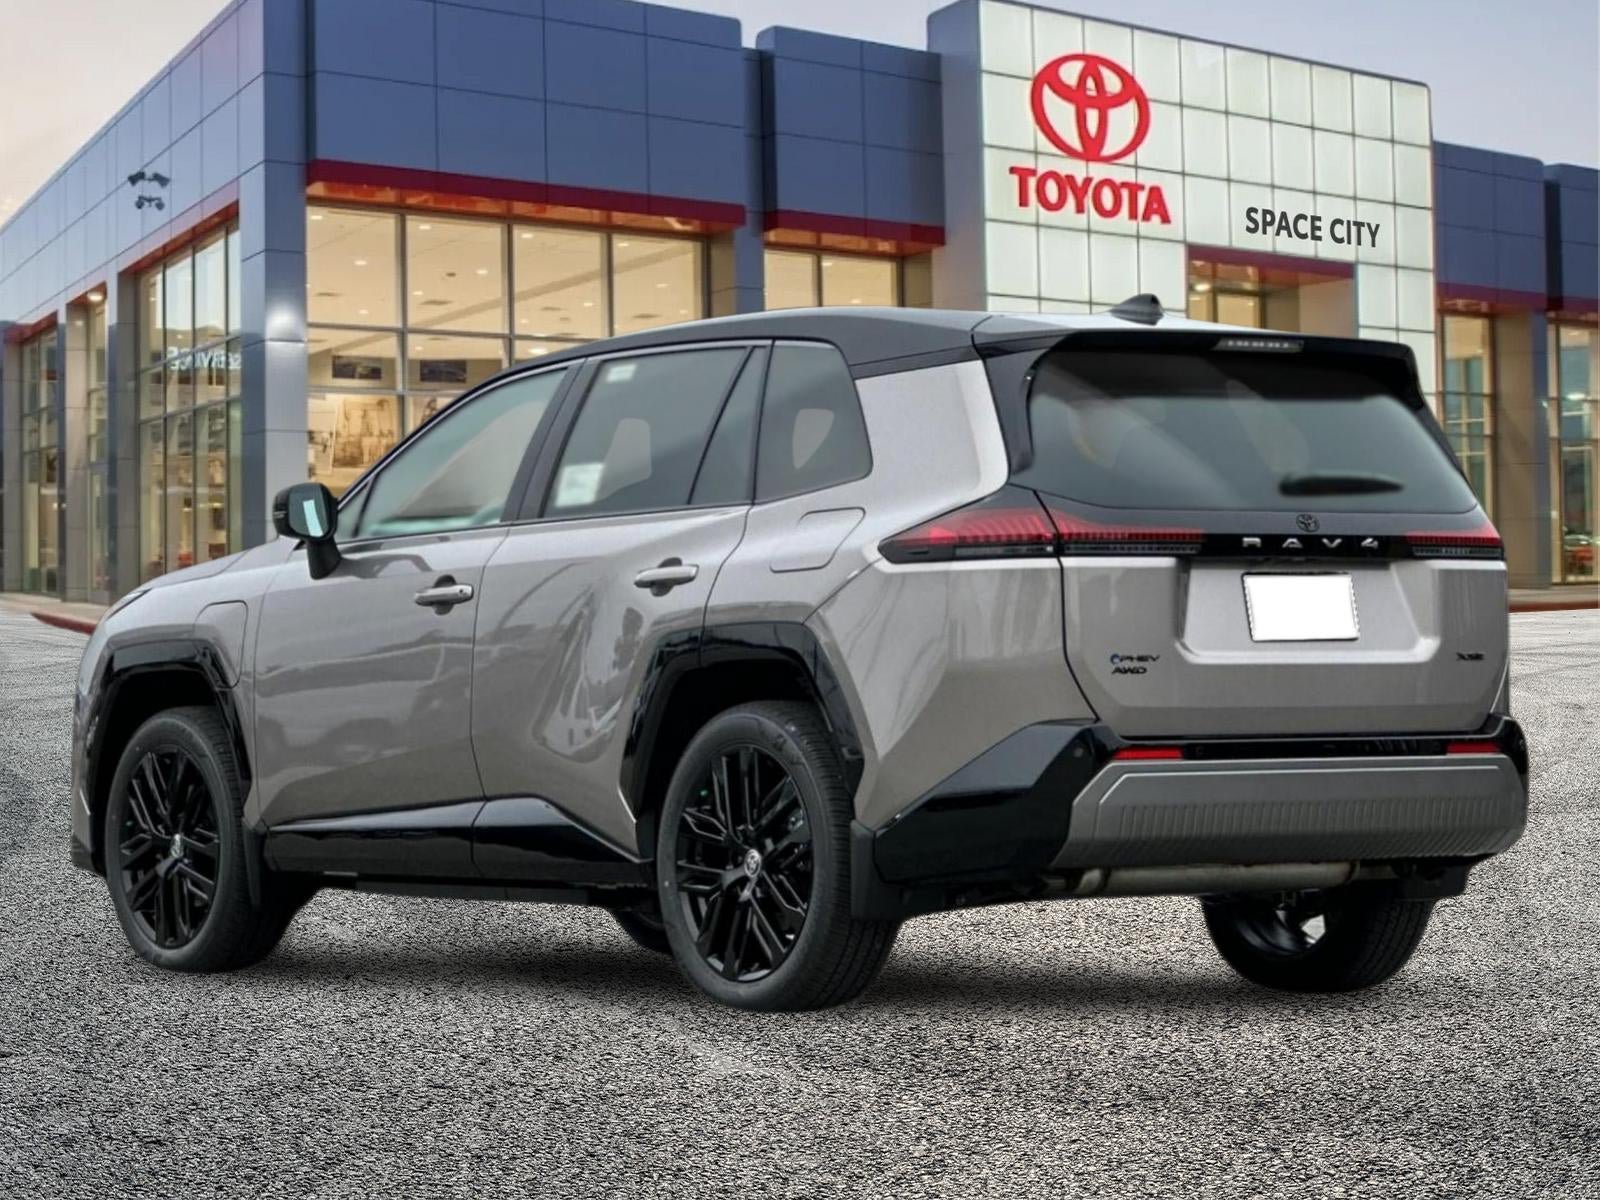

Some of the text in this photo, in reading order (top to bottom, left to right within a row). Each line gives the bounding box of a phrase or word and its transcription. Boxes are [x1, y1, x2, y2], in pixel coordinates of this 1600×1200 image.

[1009, 166, 1171, 225] TOYOTA
[1245, 206, 1380, 248] SPACE CITY
[1111, 666, 1148, 676] AWD
